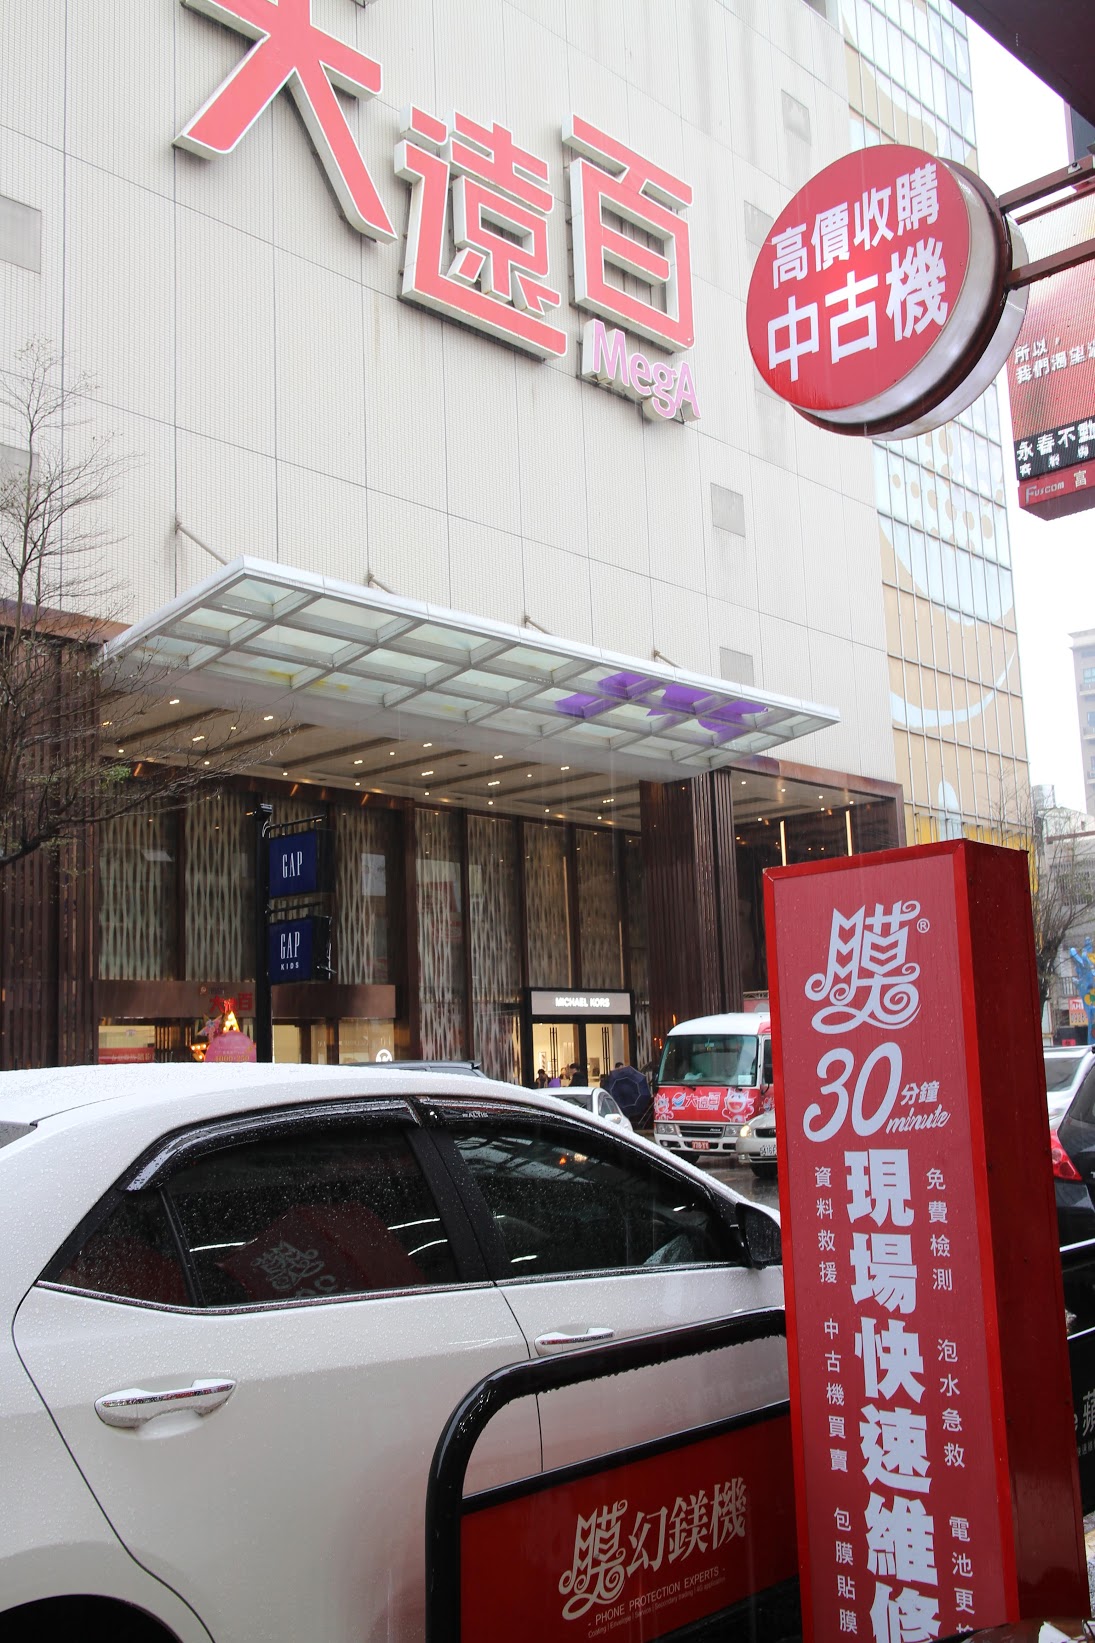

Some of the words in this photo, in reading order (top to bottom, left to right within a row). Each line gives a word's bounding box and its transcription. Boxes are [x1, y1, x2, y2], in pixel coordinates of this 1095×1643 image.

[173, 0, 694, 360] 大遠百
[771, 162, 940, 290] 高價收購
[767, 236, 950, 383] 中古機
[580, 319, 701, 422] MegA
[282, 851, 303, 879] GAP
[280, 931, 300, 960] GAP
[280, 963, 300, 971] KIDS
[590, 997, 610, 1008] KORS
[803, 1042, 903, 1143] 30
[886, 1105, 951, 1134] minute
[900, 1080, 940, 1106] 分鐘
[814, 1166, 838, 1284] 資料救援
[926, 1167, 953, 1291] 免費檢測
[823, 1317, 849, 1473] 中古機買賣
[843, 1148, 943, 1643] 現場快速維修
[937, 1338, 966, 1469] 泡水急救
[595, 1603, 626, 1626] PHONE
[629, 1581, 681, 1611] PROTECTION
[684, 1566, 719, 1588] EXPERTS
[833, 1507, 858, 1635] 包膜貼膜
